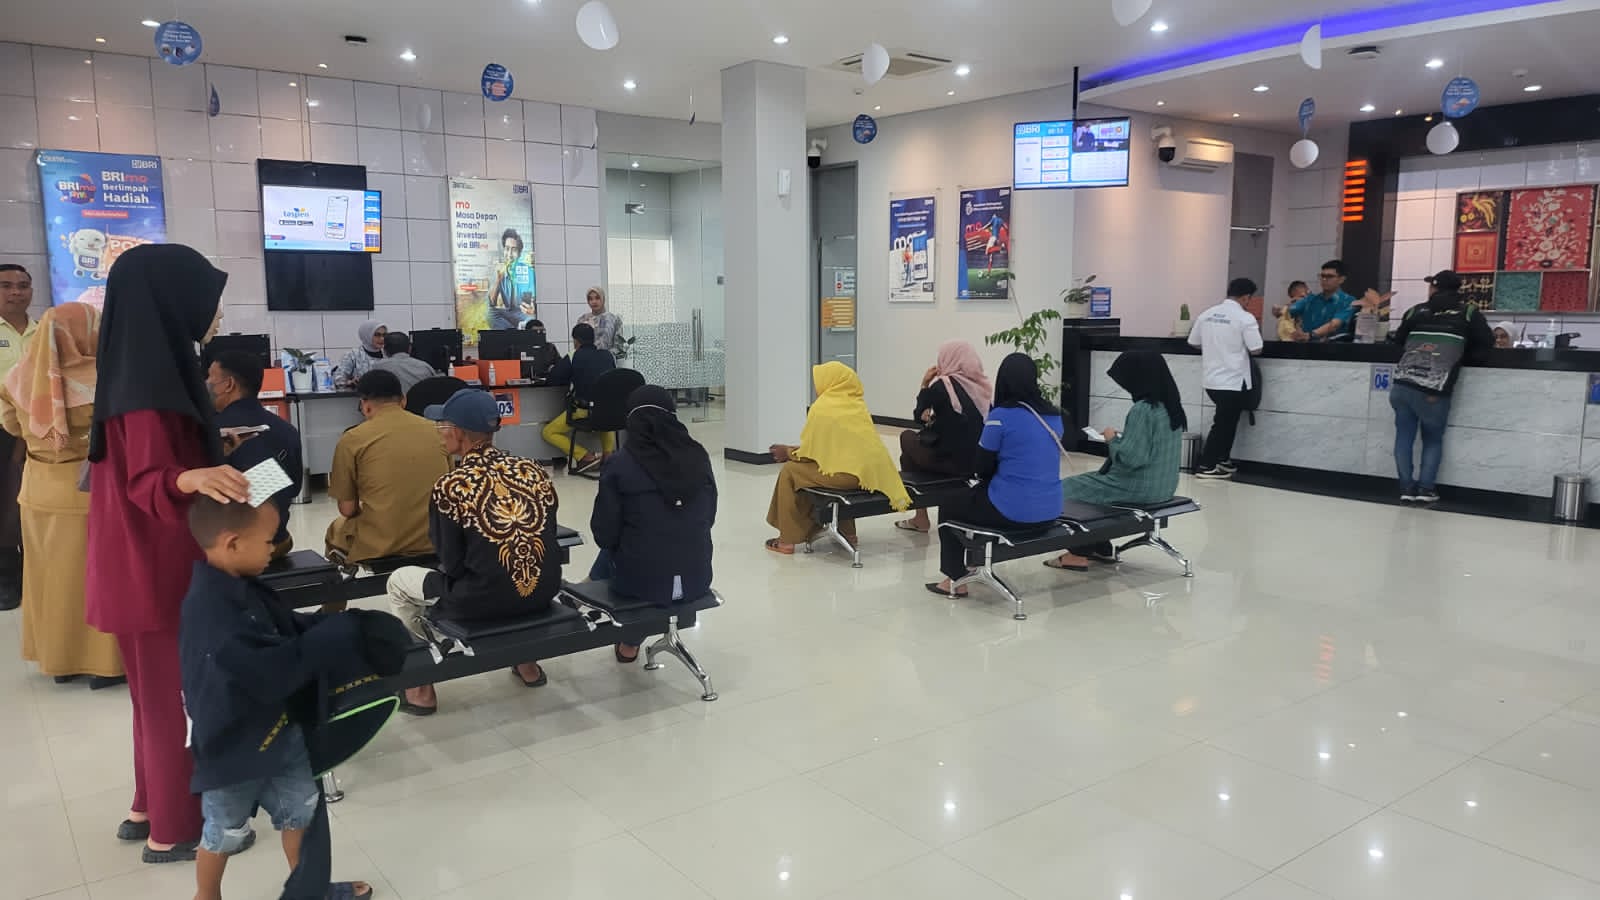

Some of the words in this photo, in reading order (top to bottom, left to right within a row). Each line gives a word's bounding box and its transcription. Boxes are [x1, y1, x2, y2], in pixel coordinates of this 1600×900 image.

[141, 160, 158, 169] BRI
[101, 171, 149, 183] BRImo
[102, 183, 149, 193] Berlimpah
[103, 193, 149, 204] Hadiah
[456, 211, 475, 219] Masa
[475, 212, 498, 221] Depan
[456, 221, 480, 229] Aman?
[81, 256, 96, 265] BRI
[498, 402, 513, 415] 03
